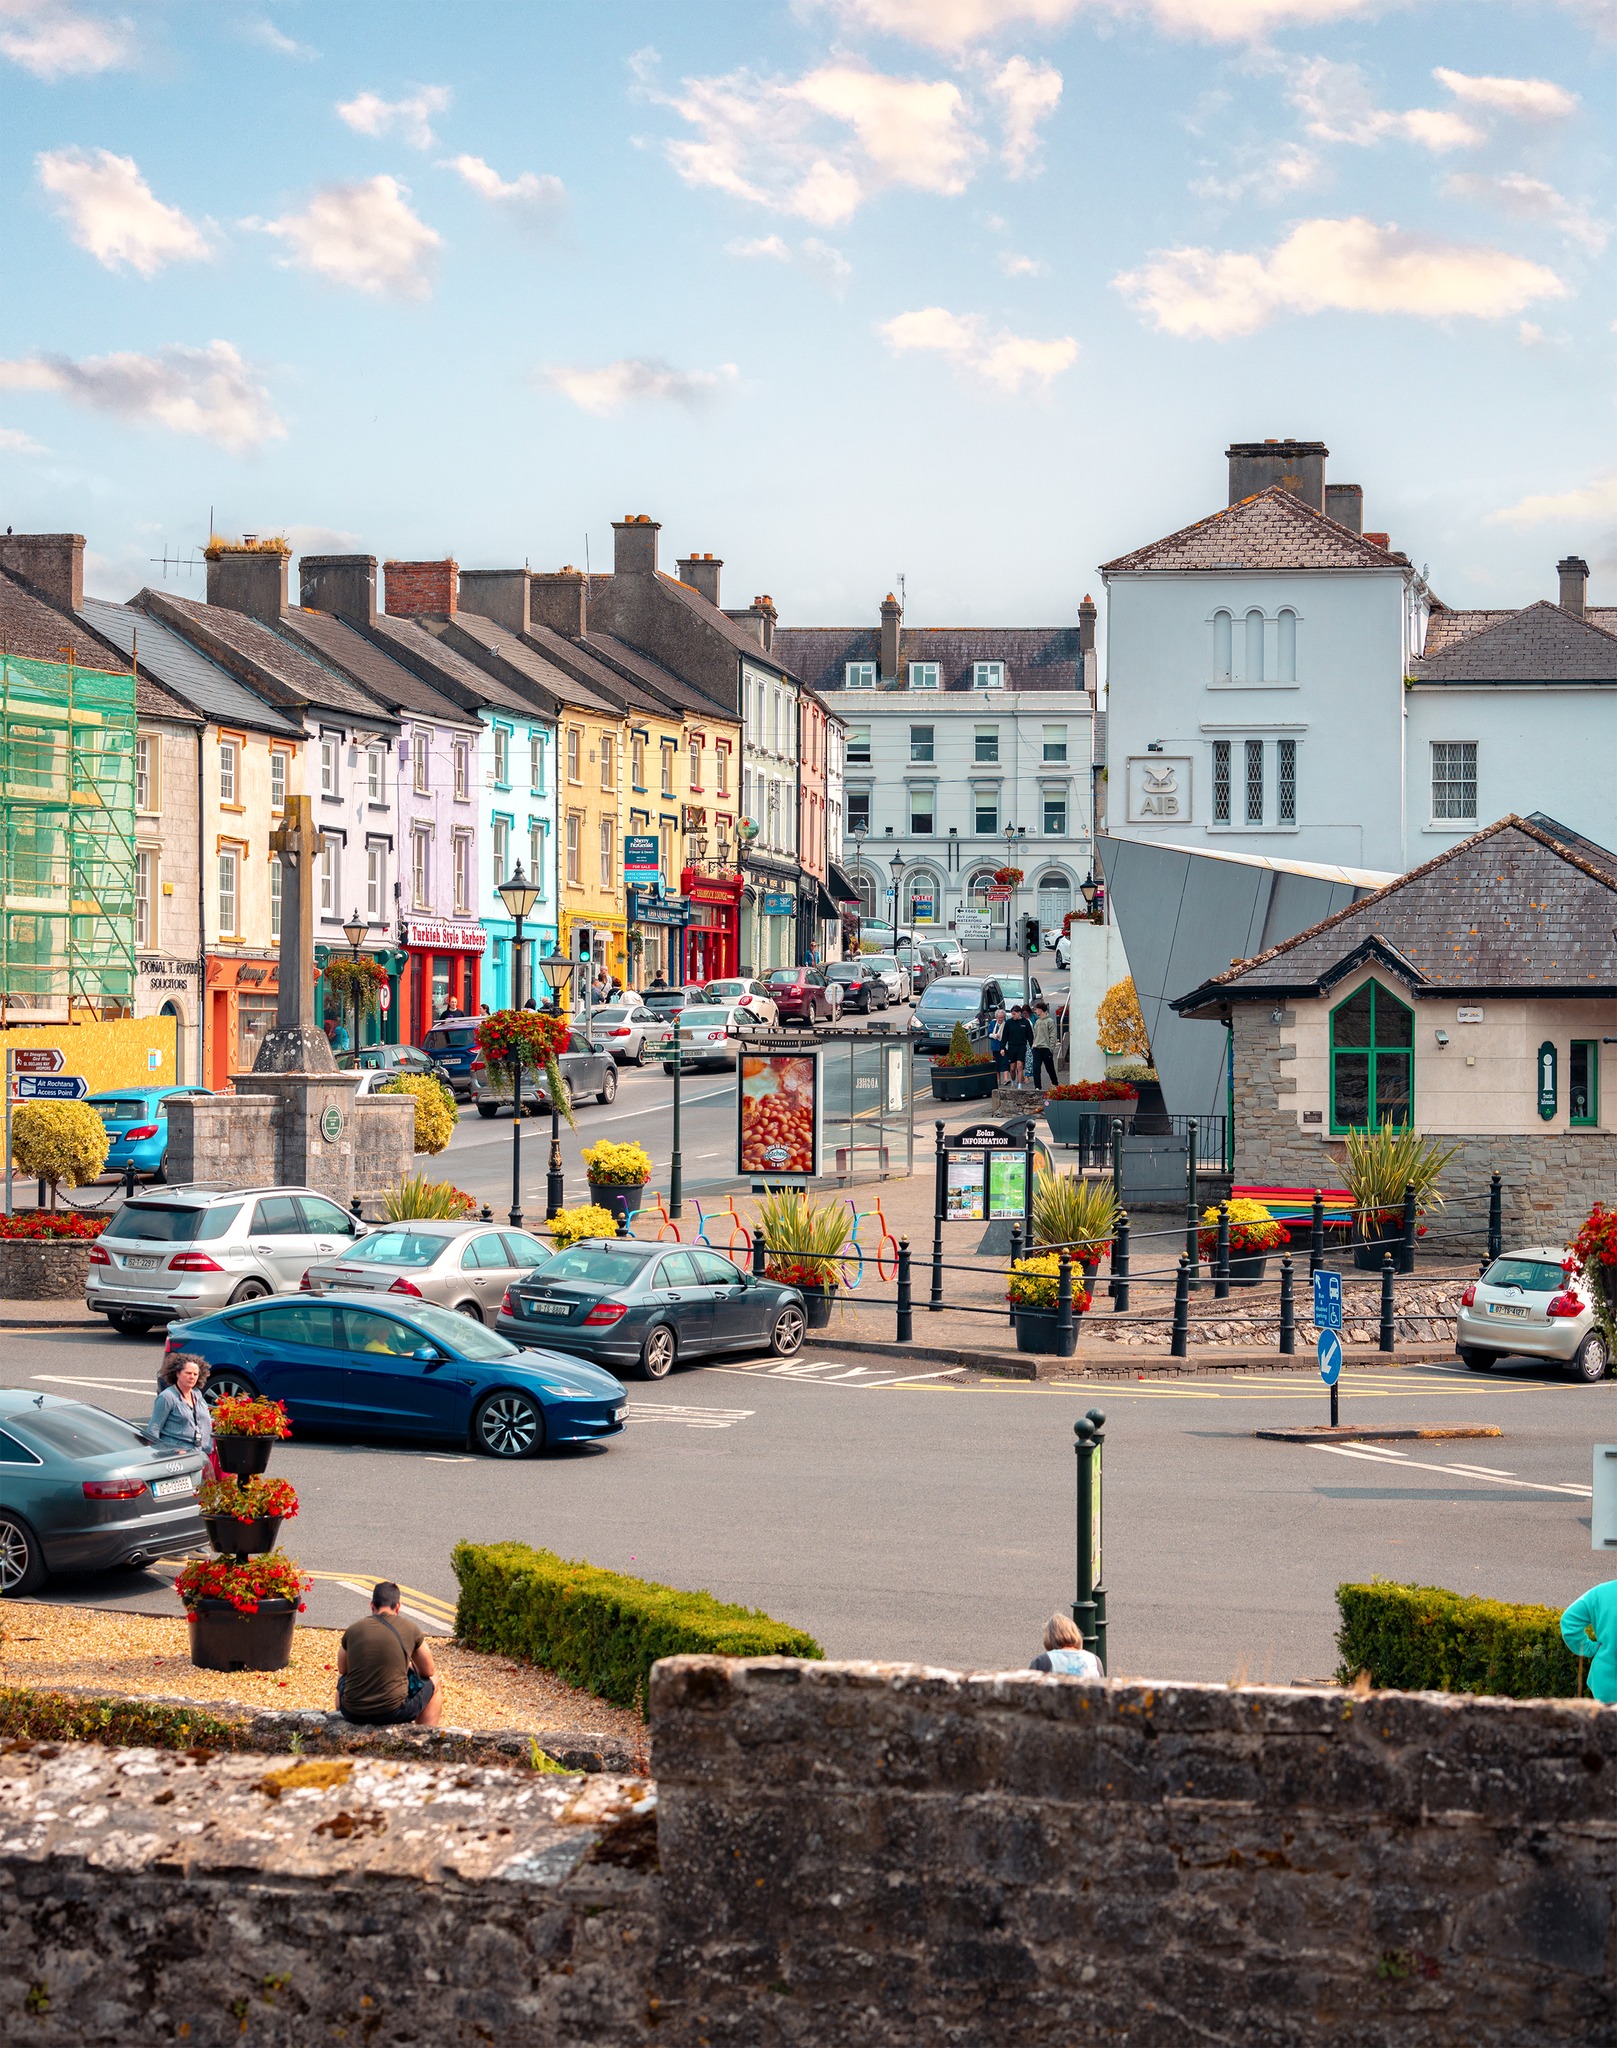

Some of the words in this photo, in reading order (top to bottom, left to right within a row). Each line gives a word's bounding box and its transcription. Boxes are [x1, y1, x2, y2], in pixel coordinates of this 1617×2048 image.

[1140, 796, 1179, 815] AIB
[413, 926, 440, 942] Turkish
[442, 929, 459, 948] Style
[461, 930, 486, 946] Barbers
[140, 961, 167, 974] DONAL
[150, 978, 187, 990] SOLICITORS
[962, 1137, 1009, 1145] INFORMATION
